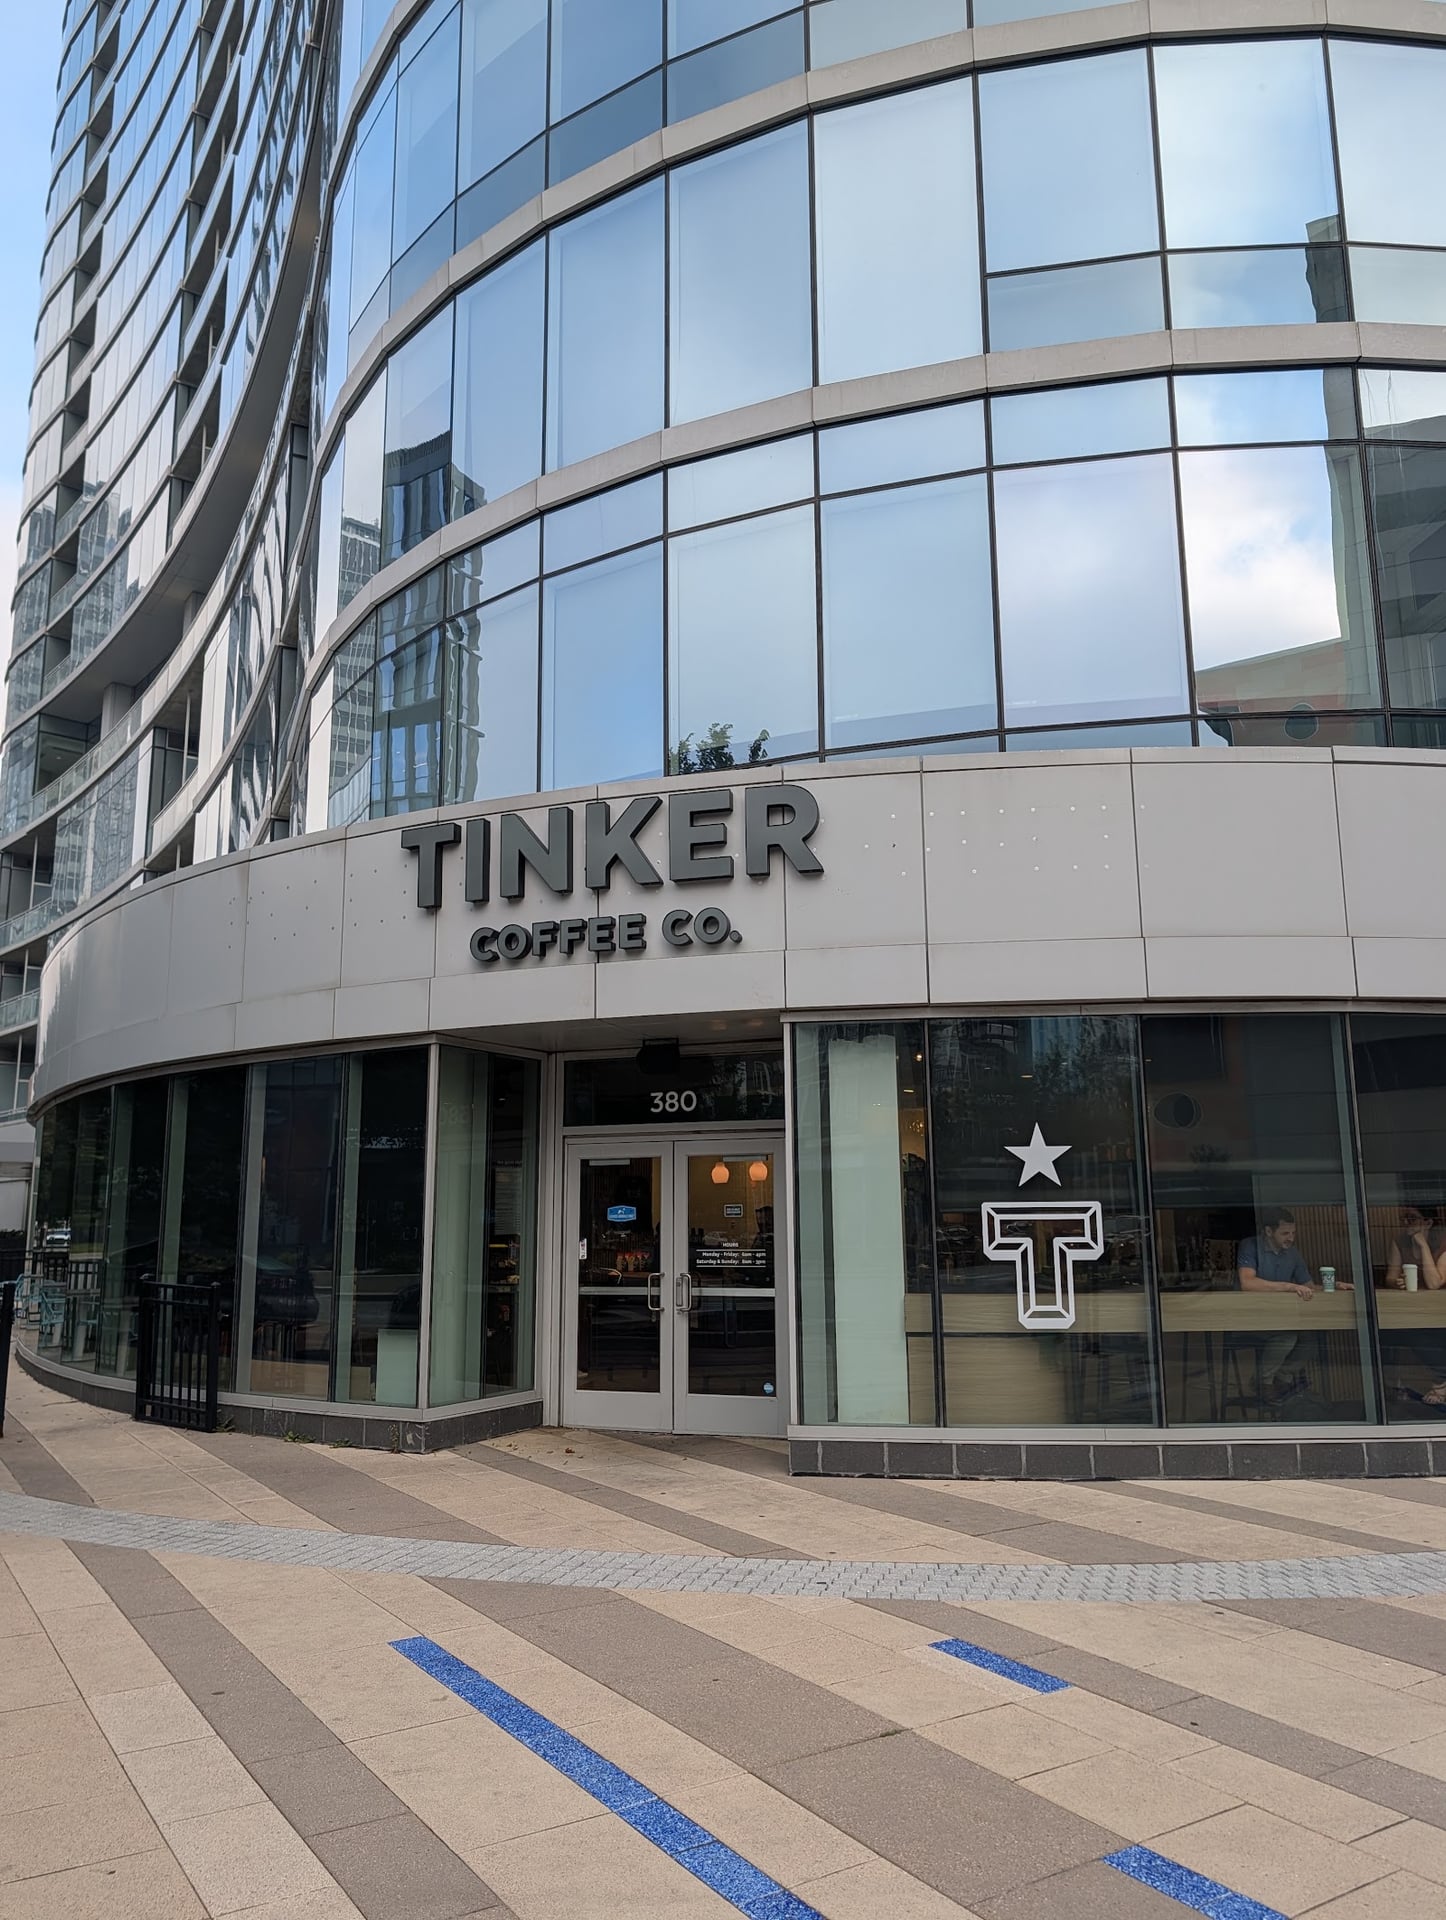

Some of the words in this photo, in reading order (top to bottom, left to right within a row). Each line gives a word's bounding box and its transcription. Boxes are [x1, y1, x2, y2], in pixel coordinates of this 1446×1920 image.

[401, 784, 824, 909] TINKER
[470, 913, 647, 962] COFFEE
[661, 907, 743, 946] CO.
[650, 1090, 697, 1112] 380
[981, 1201, 1104, 1329] T
